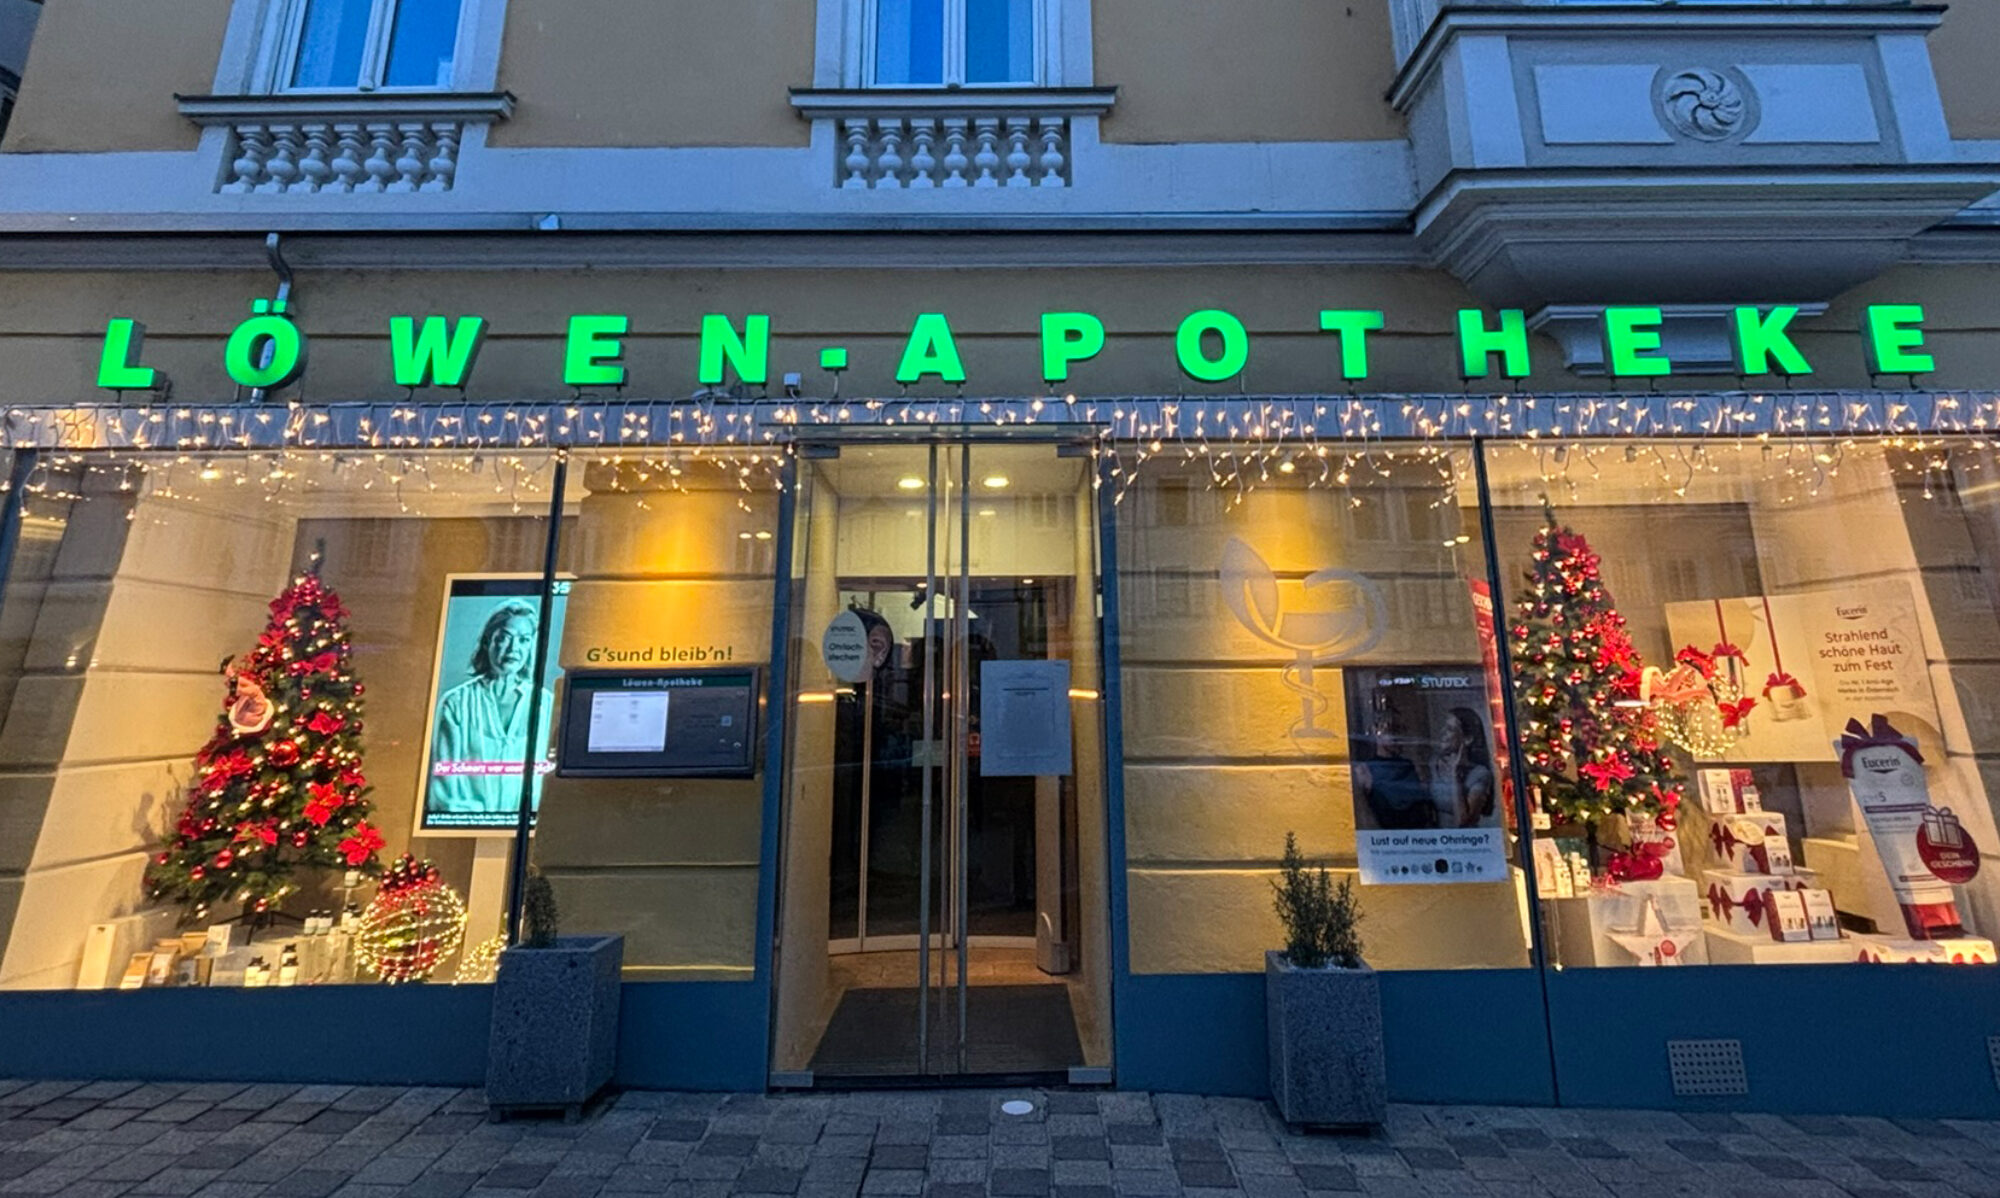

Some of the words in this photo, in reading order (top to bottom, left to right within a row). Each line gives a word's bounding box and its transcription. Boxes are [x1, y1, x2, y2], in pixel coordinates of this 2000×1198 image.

[1824, 628, 1889, 643] Strahlend
[1819, 645, 1866, 659] schöne
[1869, 645, 1903, 656] Haut
[1833, 661, 1862, 673] zum
[1866, 660, 1894, 671] Fest
[1421, 676, 1469, 688] STUDEX
[1861, 755, 1901, 769] Eucerin
[1371, 836, 1390, 846] Lust
[1392, 836, 1409, 846] auf
[1412, 837, 1438, 846] neue
[1440, 834, 1489, 847] Ohrringe?
